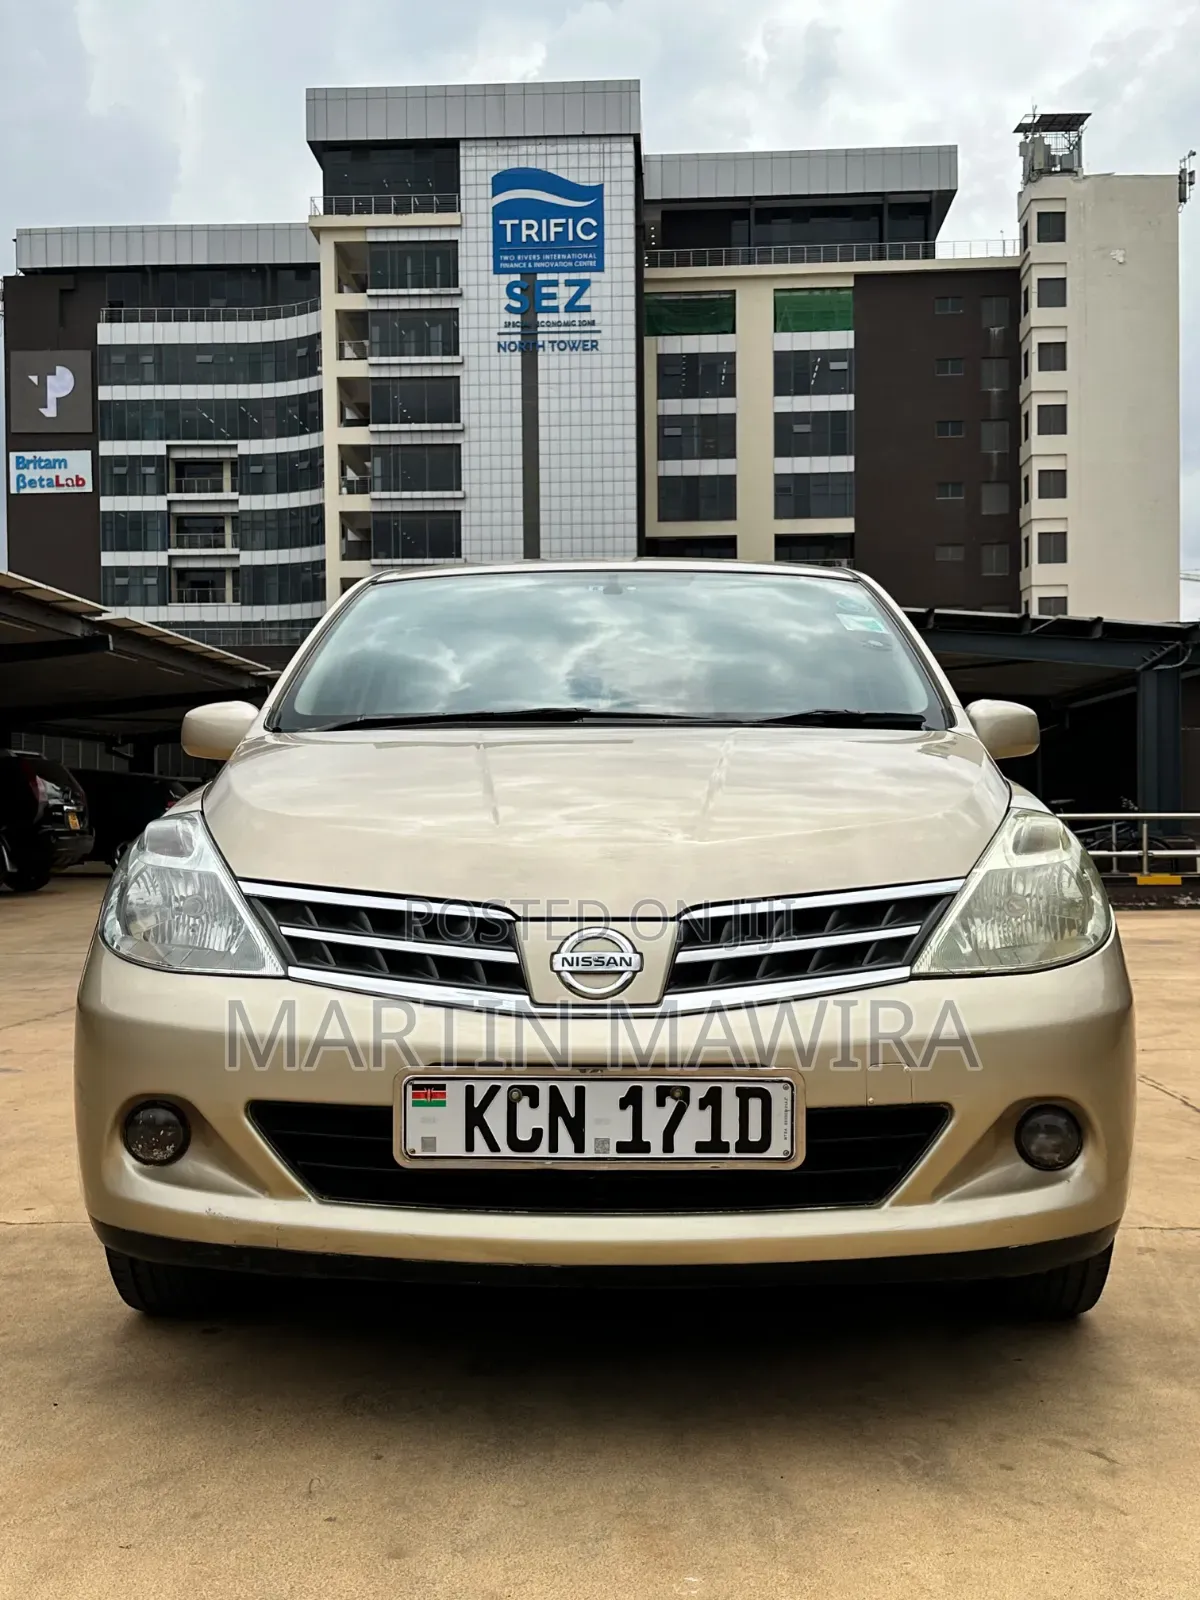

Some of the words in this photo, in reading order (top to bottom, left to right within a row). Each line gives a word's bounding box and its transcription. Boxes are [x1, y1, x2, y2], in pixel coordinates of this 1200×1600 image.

[499, 218, 597, 242] TRIFIC
[504, 279, 591, 315] SEZ
[504, 320, 535, 328] SPECIA
[577, 319, 596, 327] ZONE
[497, 340, 546, 353] NORTH
[548, 339, 599, 352] TOWER
[15, 455, 68, 470] Britam
[561, 956, 632, 967] NISSAN
[464, 1084, 586, 1154] KCN
[615, 1084, 773, 1154] 171D
